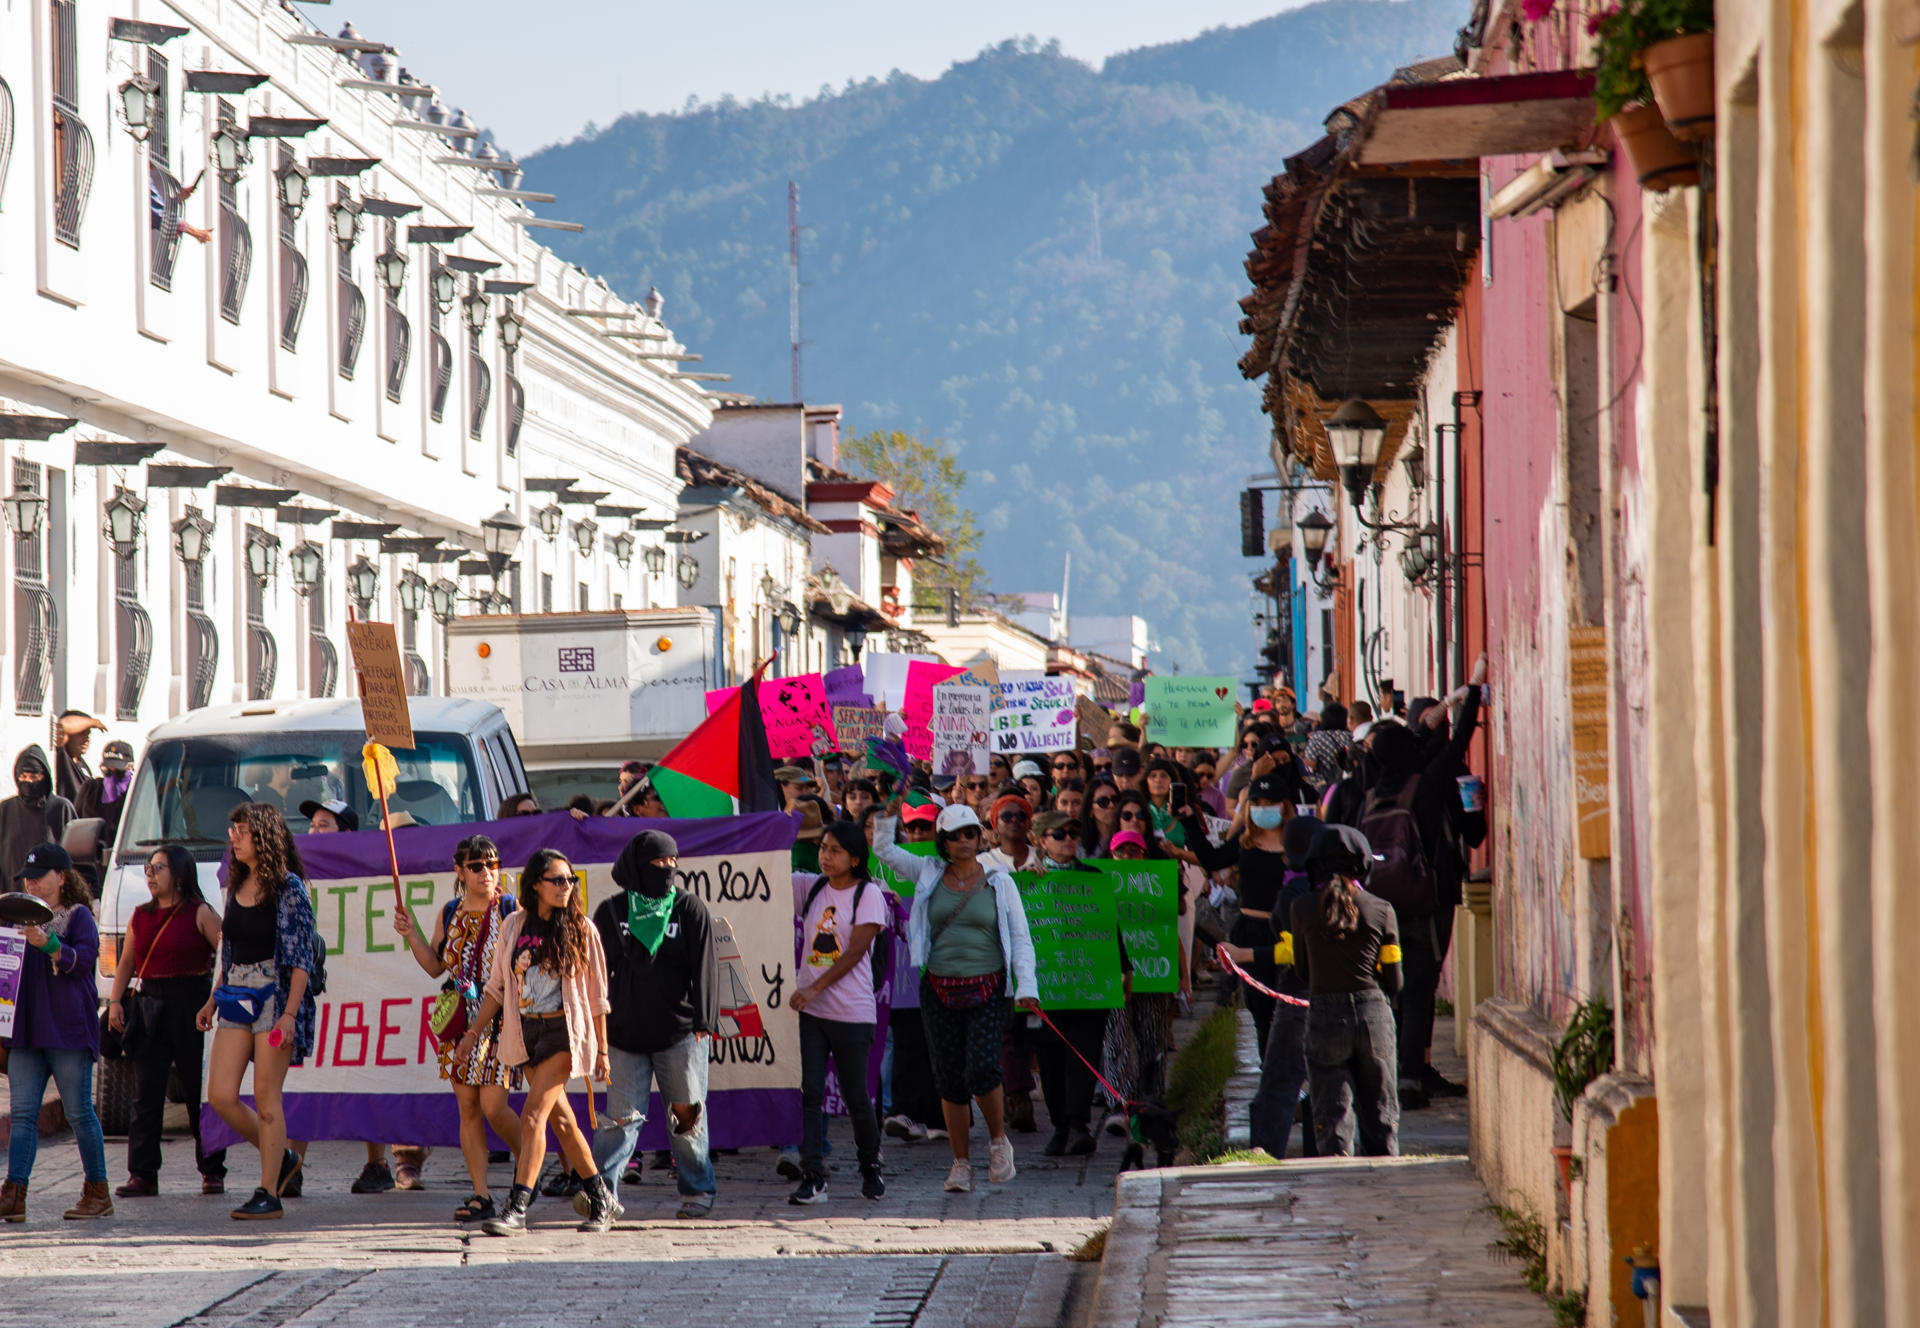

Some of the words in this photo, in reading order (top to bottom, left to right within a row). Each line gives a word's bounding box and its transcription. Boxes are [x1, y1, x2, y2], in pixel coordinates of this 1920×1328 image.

[524, 675, 566, 692] CASA
[583, 675, 629, 690] ALMA
[1043, 680, 1073, 698] SOLA
[1152, 715, 1168, 729] NO
[1194, 718, 1218, 729] AMA
[970, 730, 988, 745] NO
[998, 733, 1018, 751] NO
[1020, 730, 1073, 750] VALIENTE
[717, 860, 771, 903] las
[761, 962, 784, 1010] y
